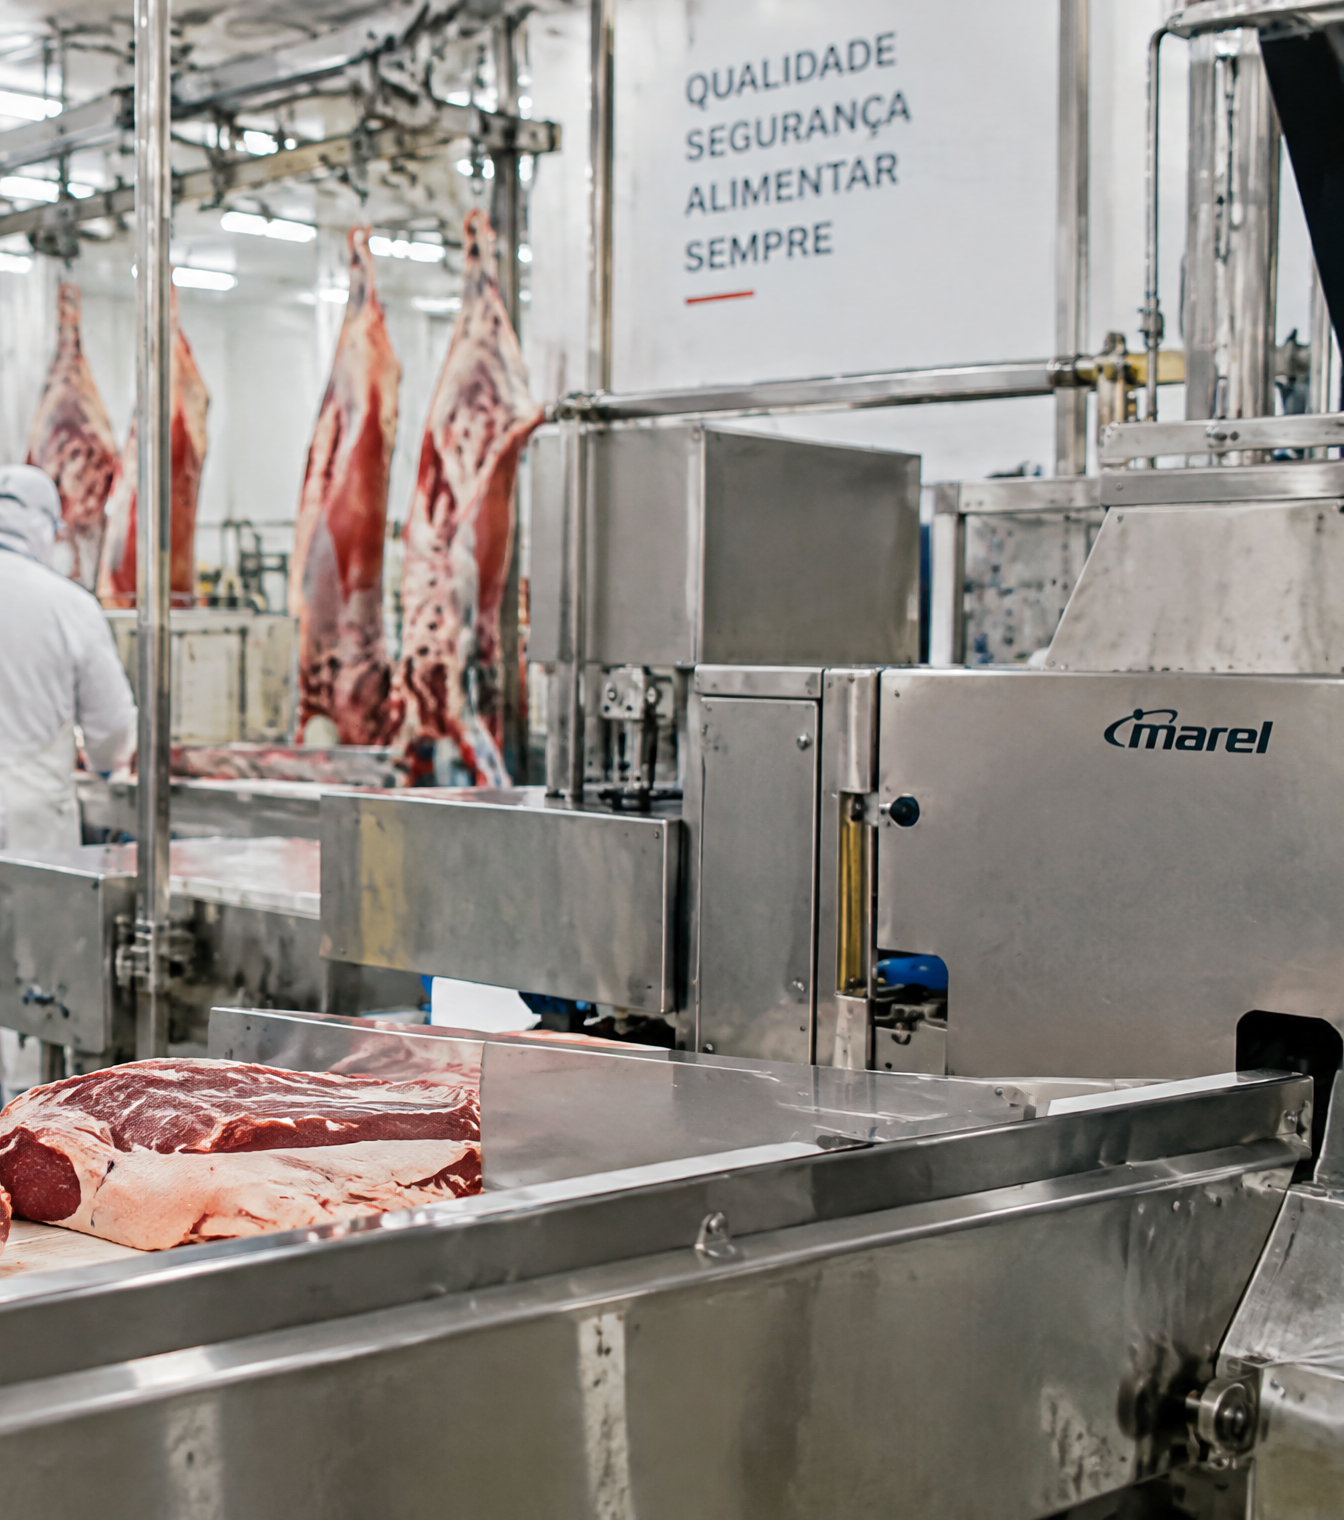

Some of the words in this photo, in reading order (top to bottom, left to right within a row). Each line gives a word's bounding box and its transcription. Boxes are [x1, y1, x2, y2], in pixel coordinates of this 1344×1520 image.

[686, 31, 896, 111] QUALIDADE
[685, 89, 912, 162] SEGURANÇA
[684, 153, 898, 217] ALIMENTAR
[684, 221, 834, 273] SEMPRE
[1128, 721, 1274, 754] marel
